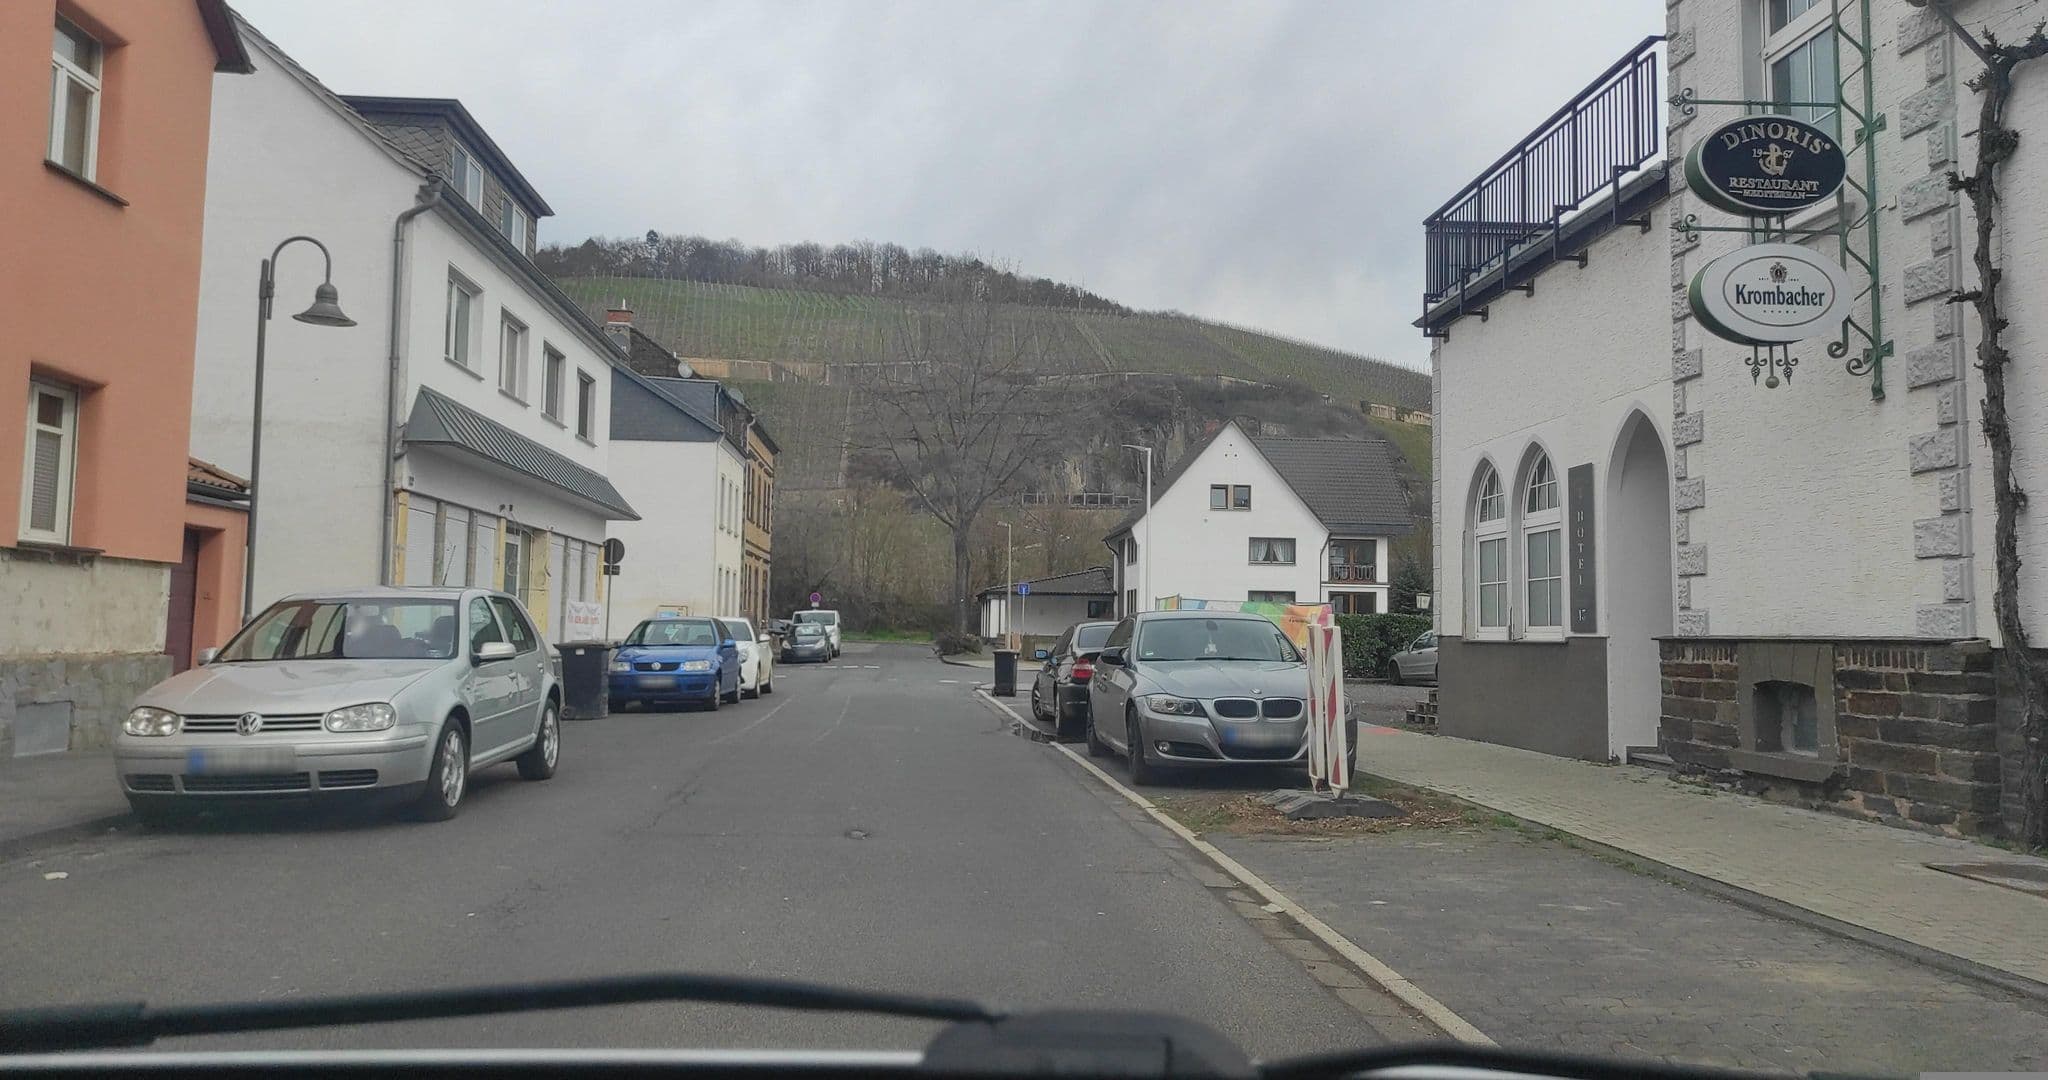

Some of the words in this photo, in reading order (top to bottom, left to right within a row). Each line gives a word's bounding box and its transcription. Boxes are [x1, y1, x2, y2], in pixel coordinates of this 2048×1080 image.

[1720, 122, 1825, 154] DINORIS
[1752, 148, 1763, 158] 19
[1728, 177, 1820, 192] RESTAURANT
[1735, 284, 1826, 307] Krombacher
